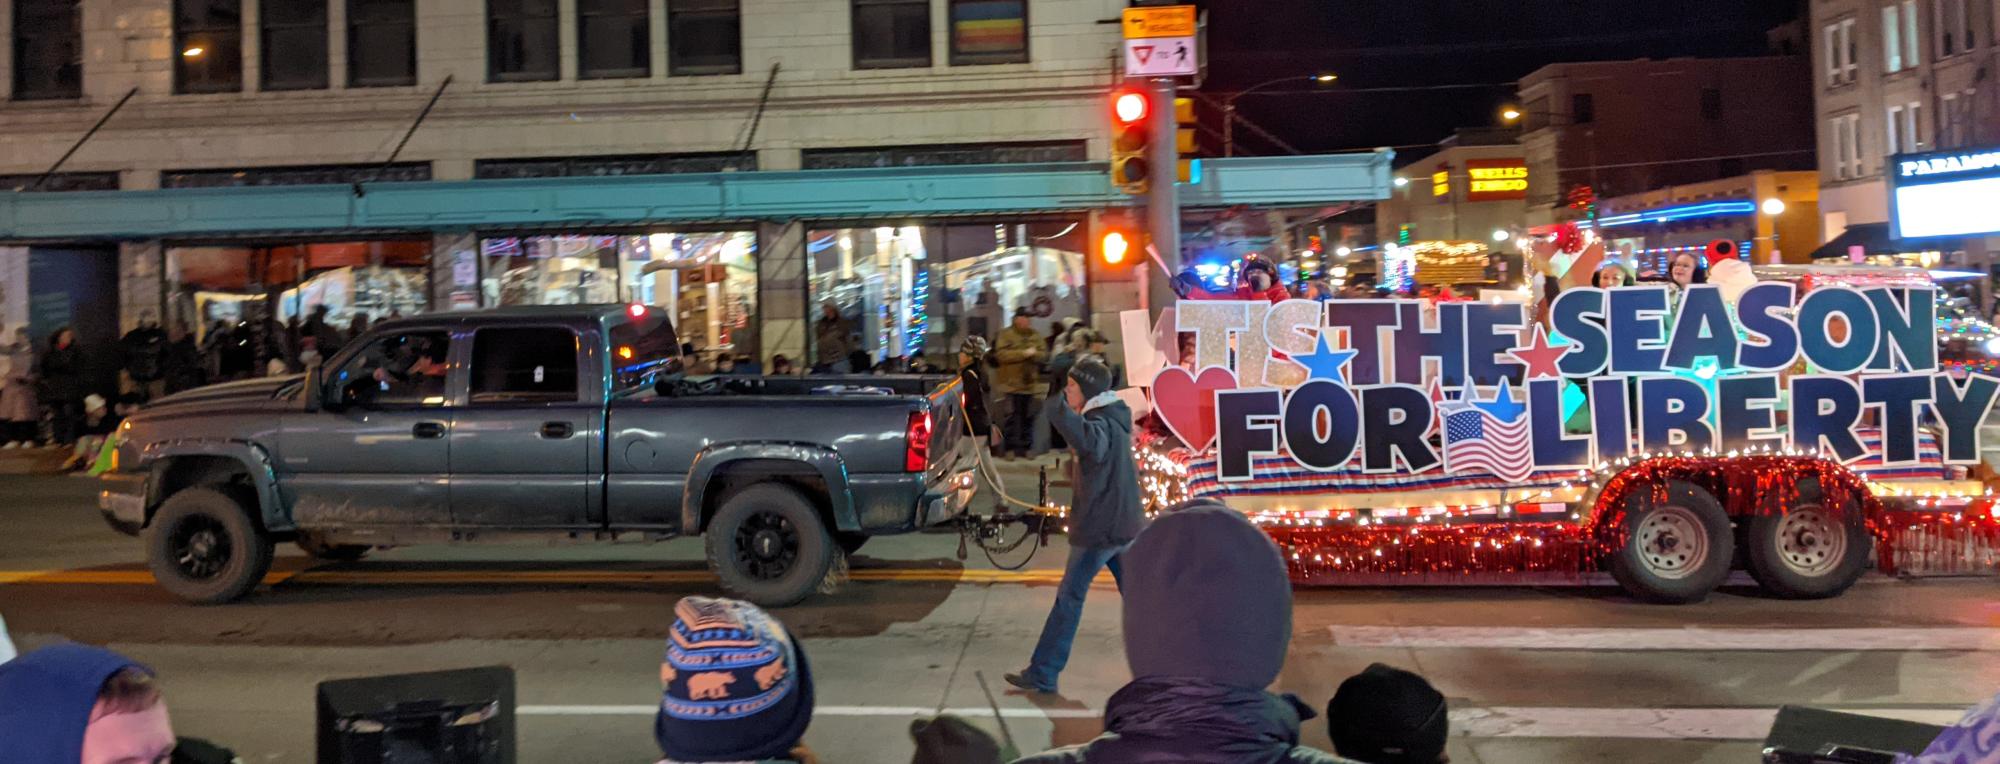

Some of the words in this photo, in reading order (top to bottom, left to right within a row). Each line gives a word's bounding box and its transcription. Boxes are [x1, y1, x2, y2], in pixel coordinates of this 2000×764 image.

[1468, 167, 1528, 179] WELLS
[1325, 298, 1526, 388] THE
[1549, 281, 1939, 378] SEASON
[1214, 378, 1441, 482] FOR
[1526, 372, 2000, 469] LIBERTY
